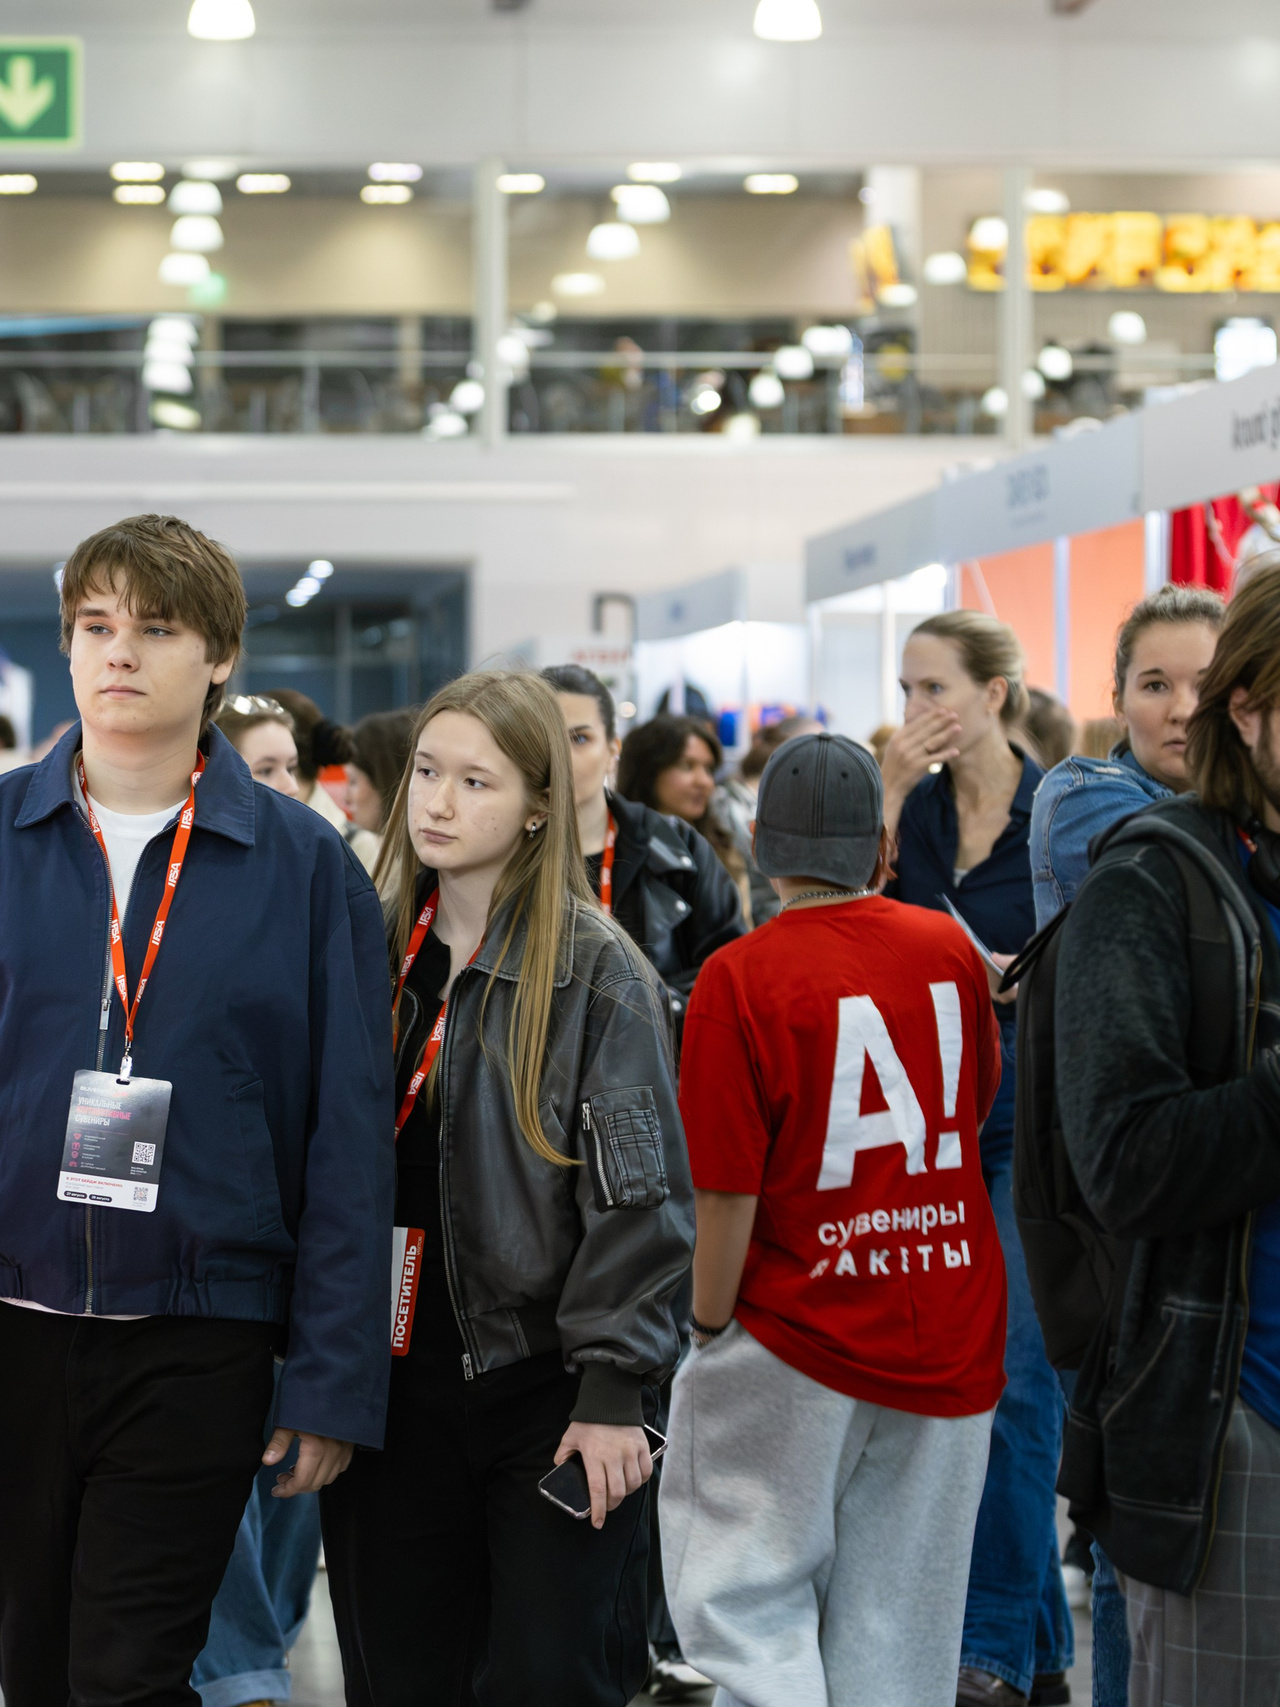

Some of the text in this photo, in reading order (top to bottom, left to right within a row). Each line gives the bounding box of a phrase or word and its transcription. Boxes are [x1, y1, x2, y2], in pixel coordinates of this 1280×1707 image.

[74, 1115, 111, 1127] СУВЕНИРЫ
[818, 1201, 965, 1249] сувениры
[392, 1245, 418, 1348] ПОСЕТИТЕЛЬ
